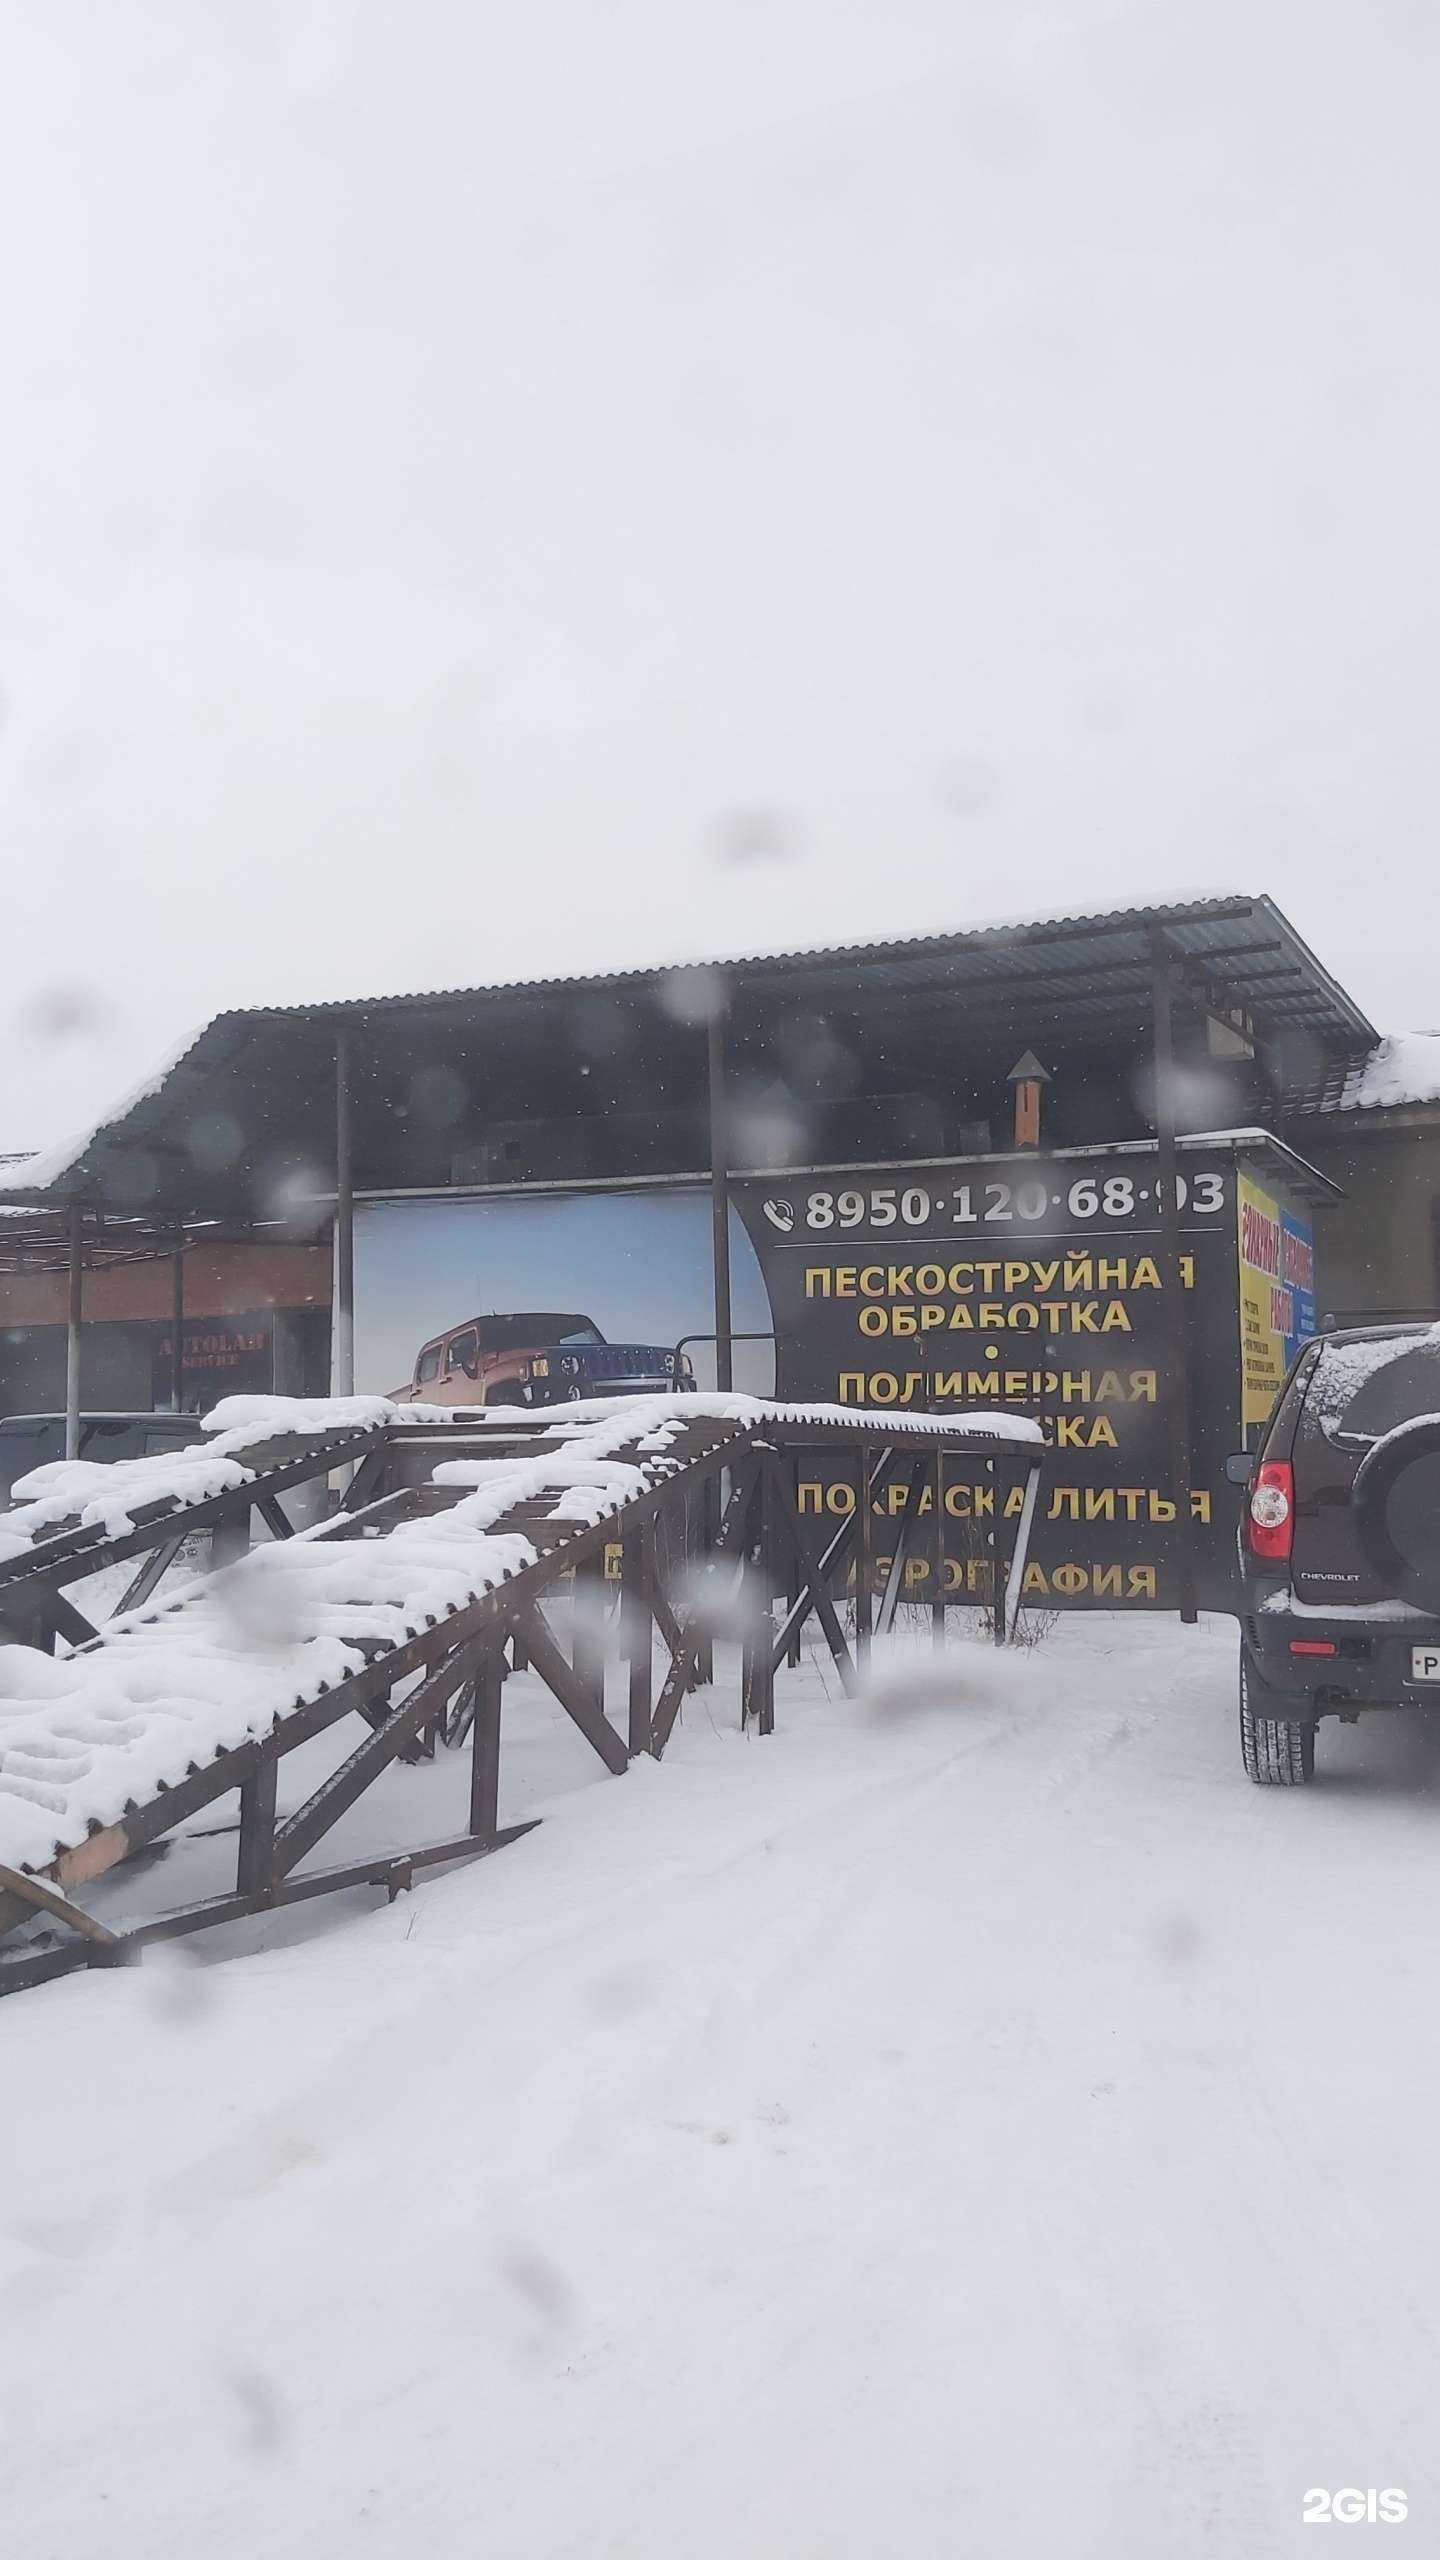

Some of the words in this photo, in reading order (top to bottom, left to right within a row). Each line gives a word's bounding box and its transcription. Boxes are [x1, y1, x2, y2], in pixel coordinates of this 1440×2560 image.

[857, 1299, 1133, 1338] ОБРАБОТКА
[838, 1369, 1158, 1404] ПОЛИМЕРНАЯ
[797, 1482, 1025, 1518] ПОРАСКА
[846, 1555, 1158, 1599] ЭРОГАФИЯ
[1300, 1571, 1360, 1582] CHEVROLET
